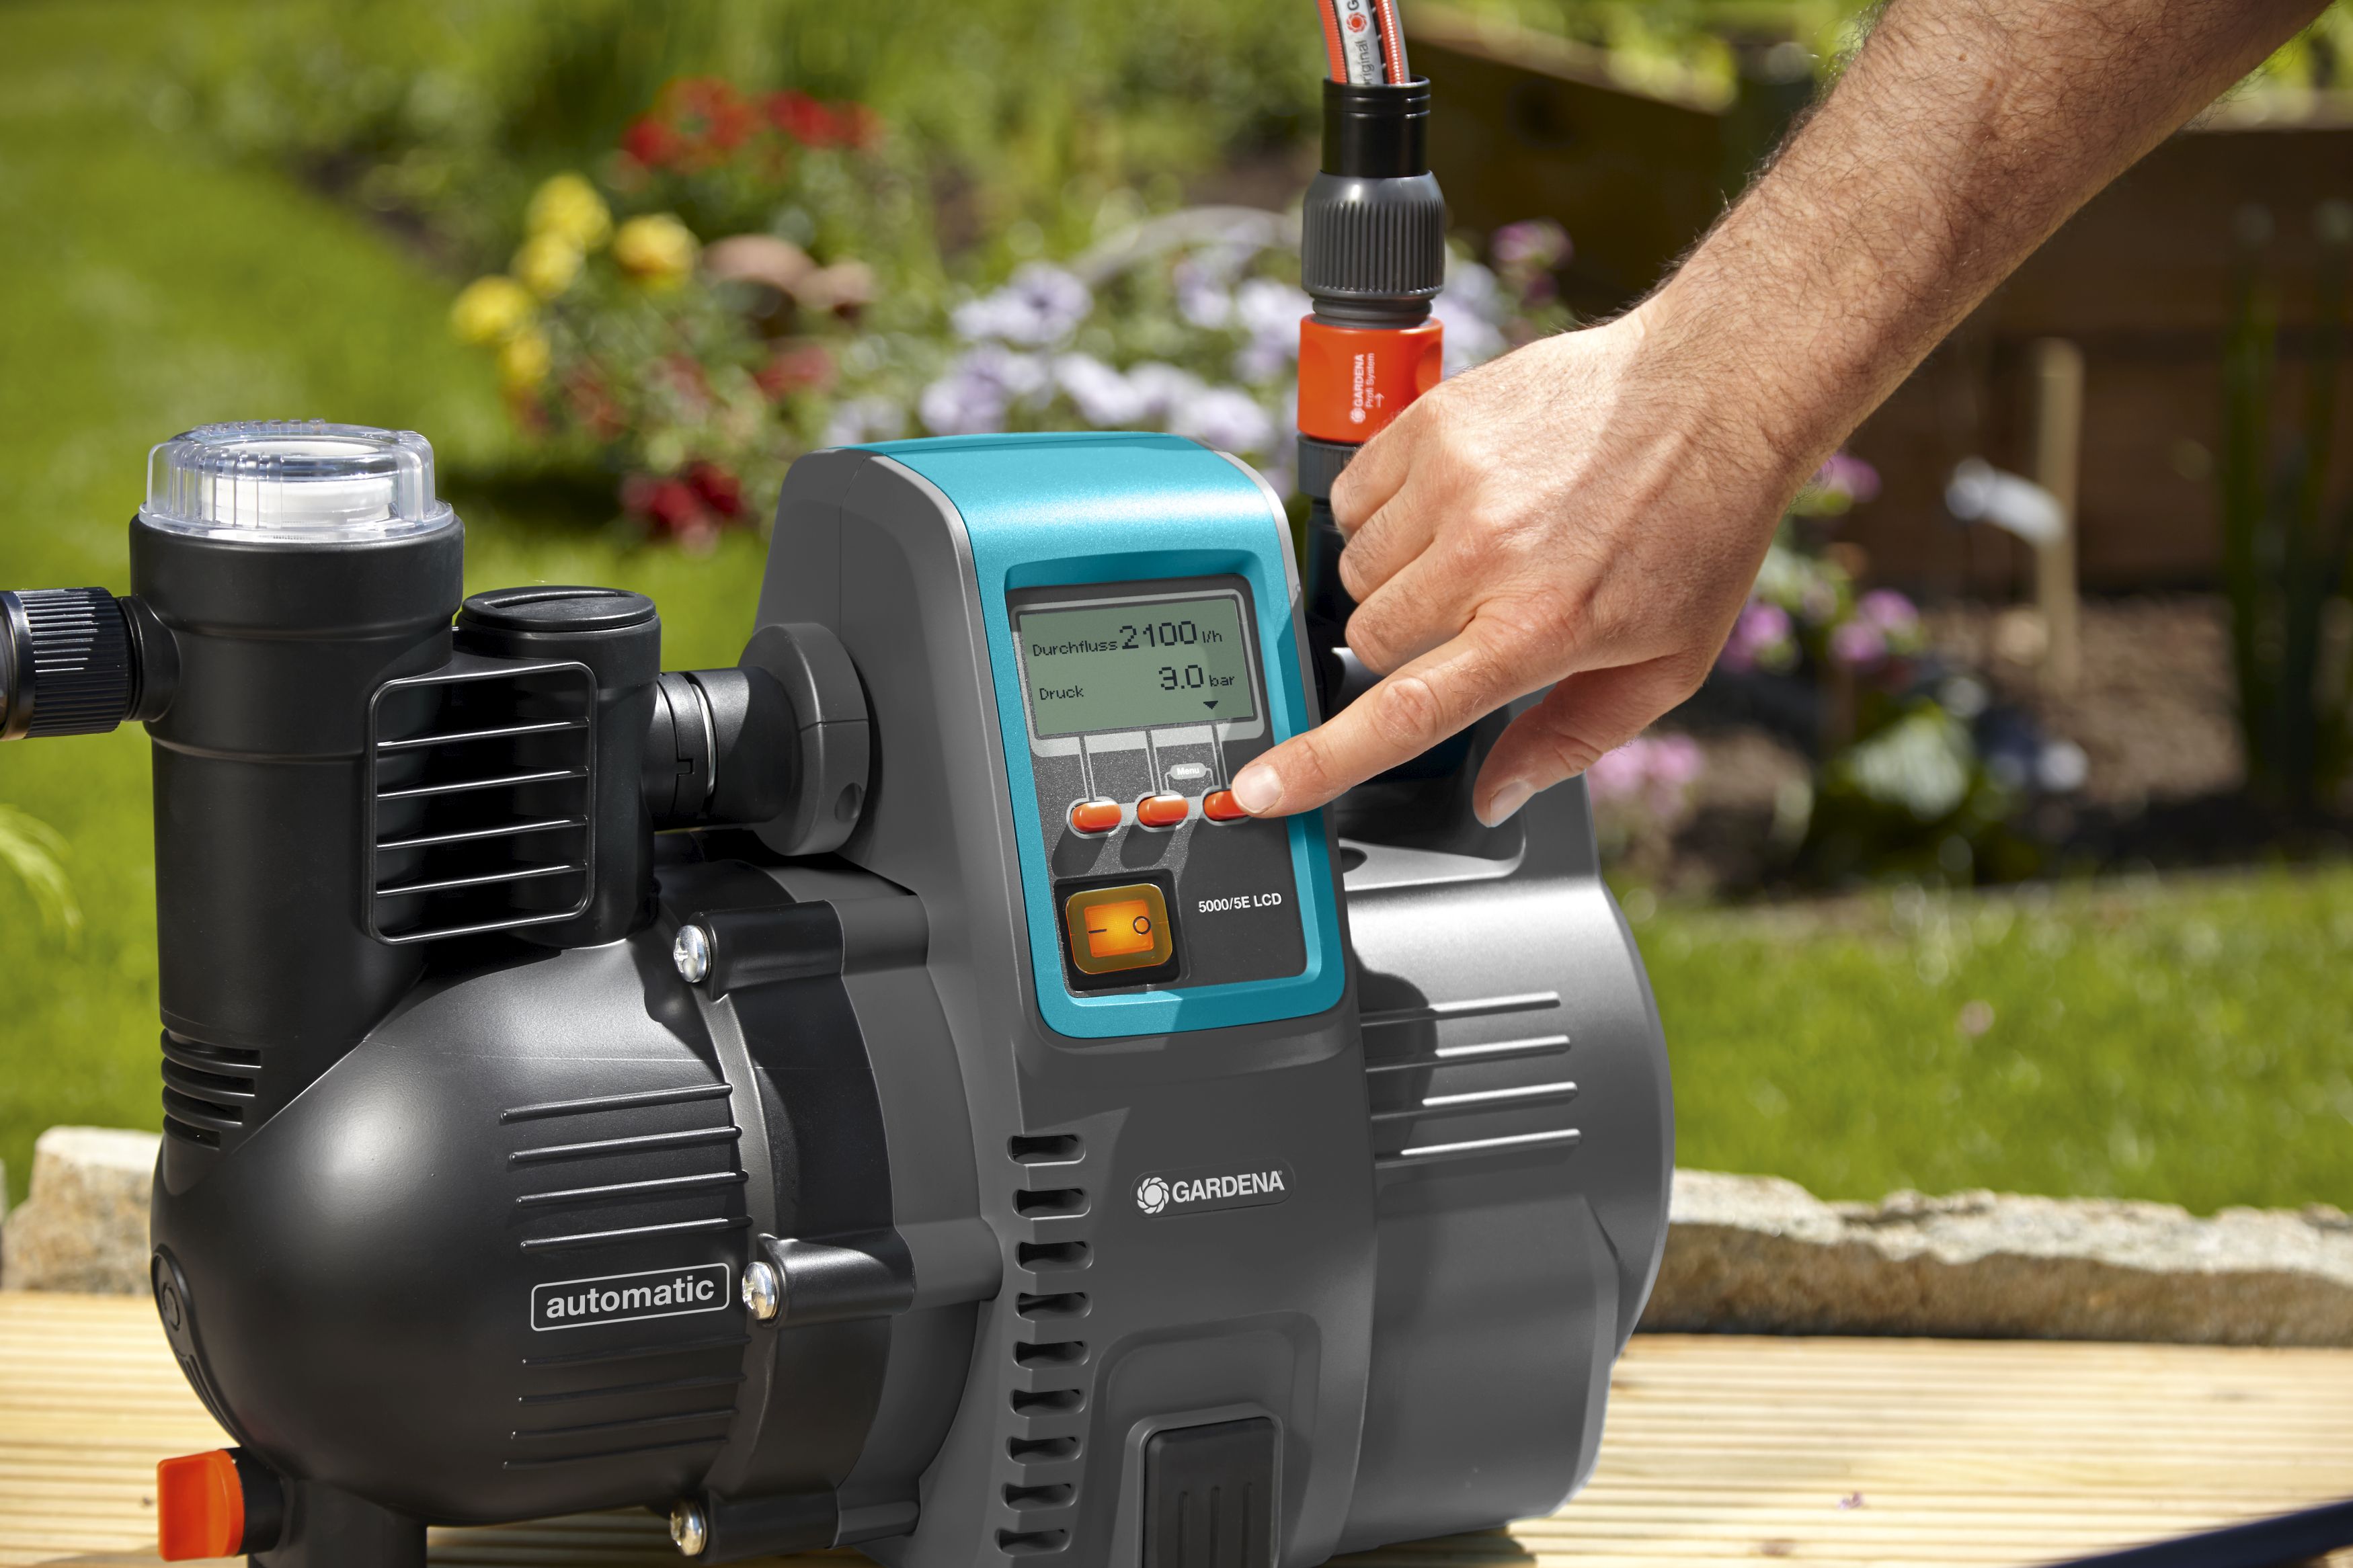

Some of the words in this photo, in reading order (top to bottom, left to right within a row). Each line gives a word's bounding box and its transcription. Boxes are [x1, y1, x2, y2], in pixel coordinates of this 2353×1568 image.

[1354, 354, 1364, 408] GARDENA
[1366, 353, 1375, 385] System
[1365, 387, 1374, 409] Profi
[1032, 640, 1118, 657] Durchfluss
[1119, 620, 1198, 650] 2100
[1202, 630, 1223, 643] l/h
[1039, 685, 1084, 700] Druck
[1158, 664, 1205, 691] 3.0
[1209, 674, 1235, 688] bar
[1176, 767, 1200, 776] Menu
[1198, 895, 1251, 913] 5000/5E
[1252, 893, 1282, 907] LCD
[1172, 1170, 1285, 1203] GARDENA
[546, 1275, 715, 1319] automatic
